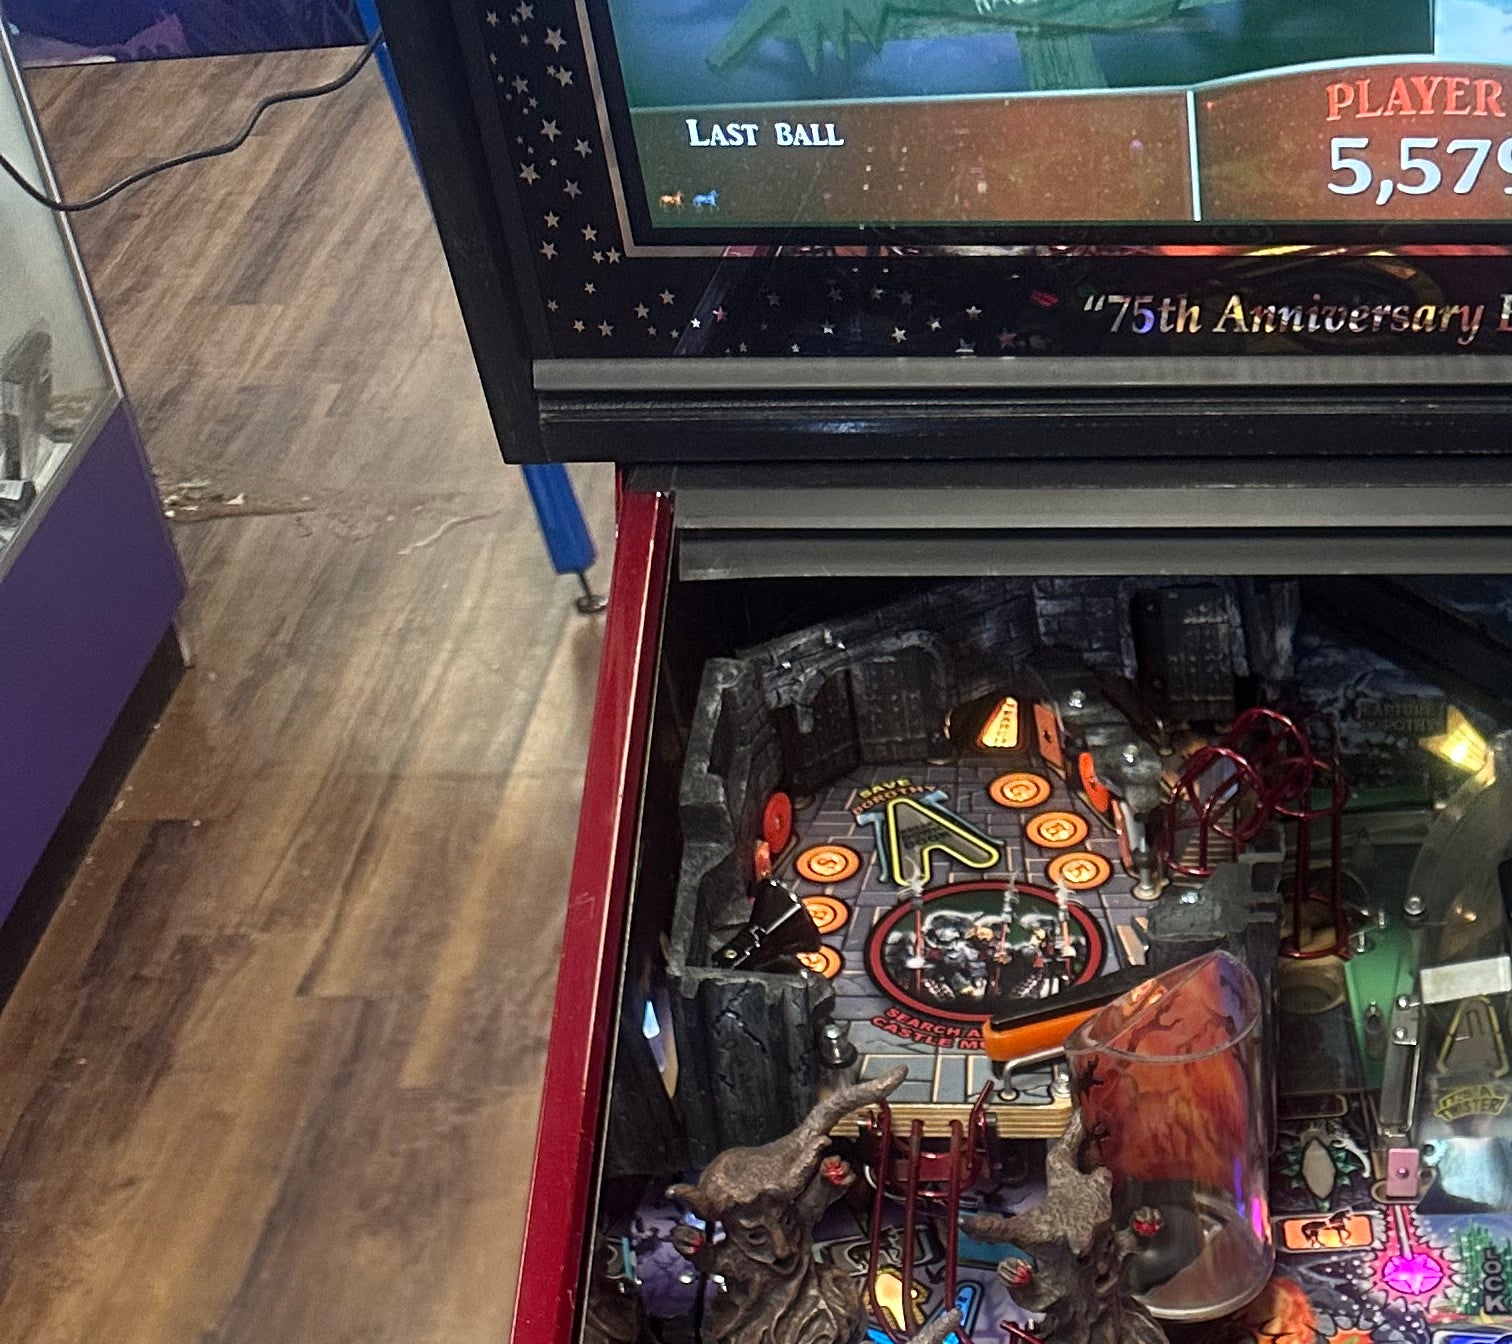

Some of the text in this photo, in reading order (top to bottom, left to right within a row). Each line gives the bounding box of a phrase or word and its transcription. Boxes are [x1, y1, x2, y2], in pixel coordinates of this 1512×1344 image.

[1327, 78, 1505, 120] PLAYER
[686, 119, 844, 147] LAST BALL
[1212, 293, 1484, 346] Anniversary
[860, 778, 912, 798] SAVE
[871, 1016, 953, 1050] CASTLE
[885, 1006, 961, 1037] SEARCH
